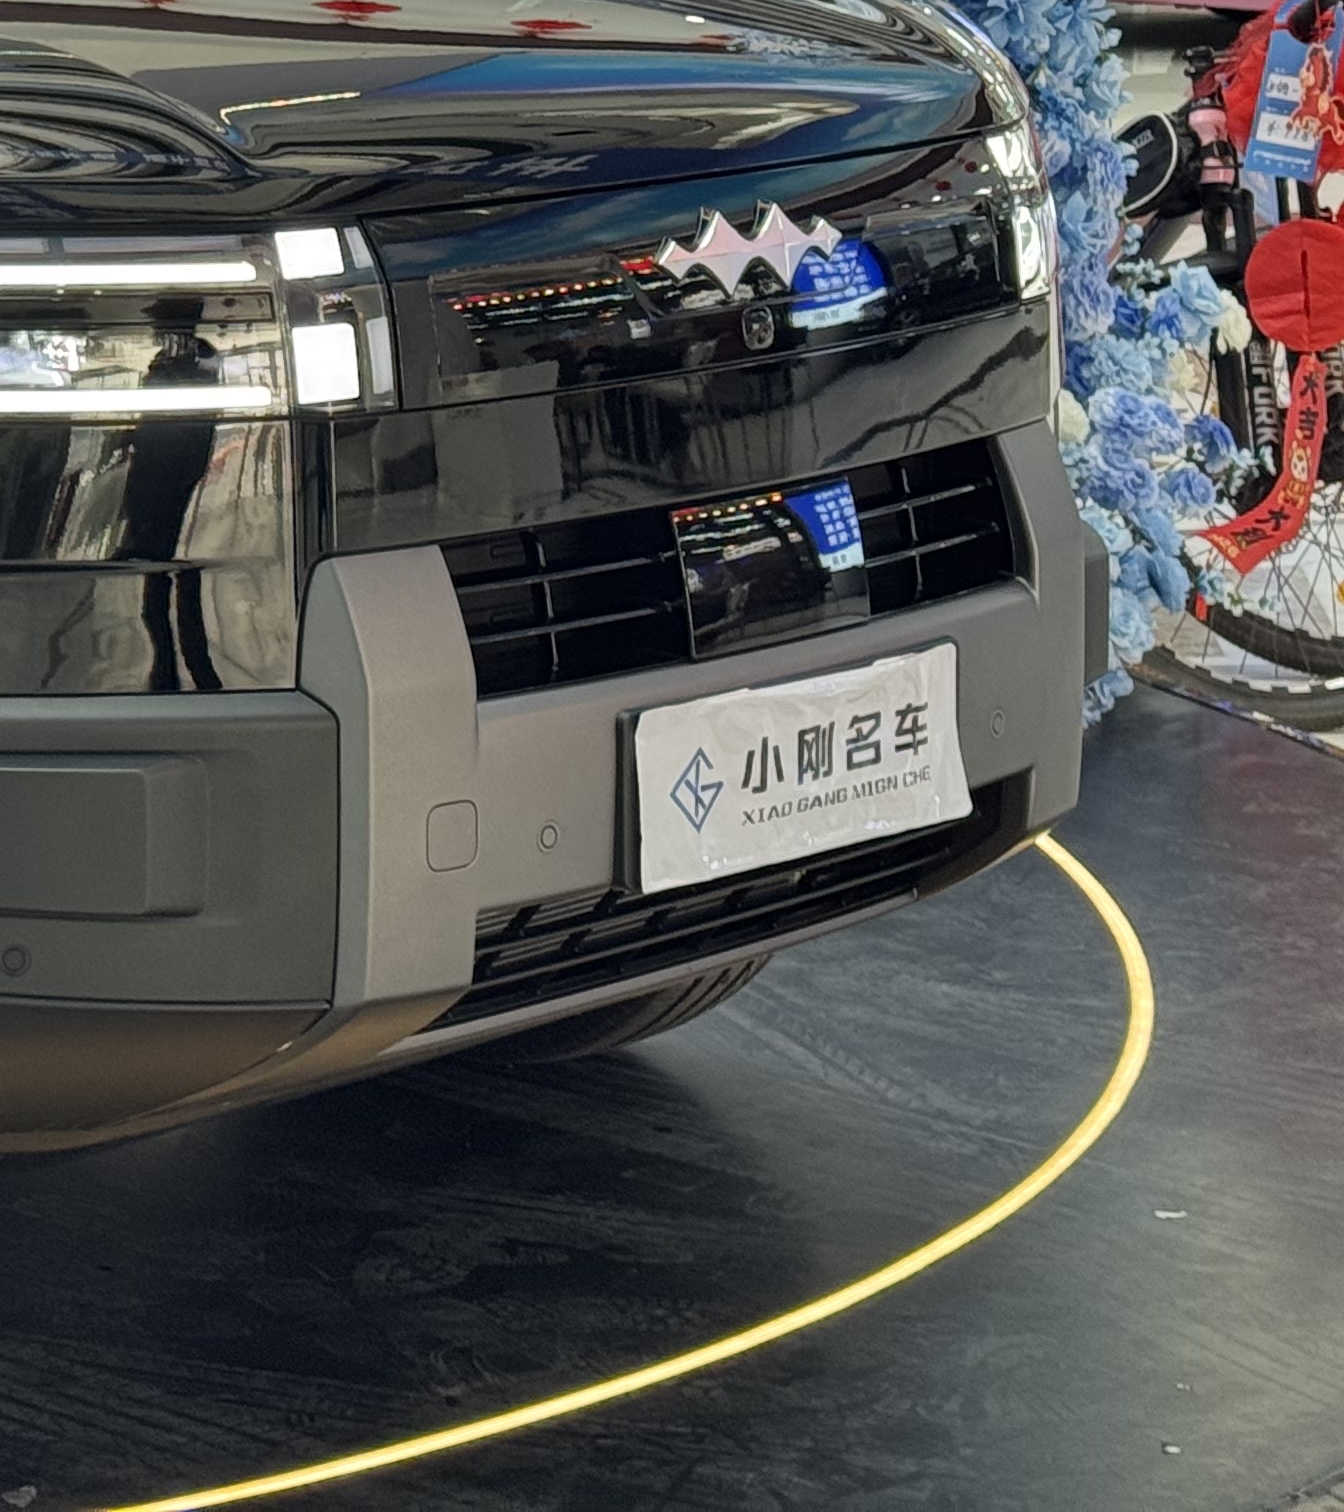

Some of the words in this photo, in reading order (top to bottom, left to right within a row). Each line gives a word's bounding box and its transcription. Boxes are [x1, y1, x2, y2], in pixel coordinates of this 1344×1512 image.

[741, 701, 929, 794] 小刚名车
[741, 800, 793, 826] XIAO
[796, 787, 849, 815] GANG
[902, 764, 931, 789] CHE
